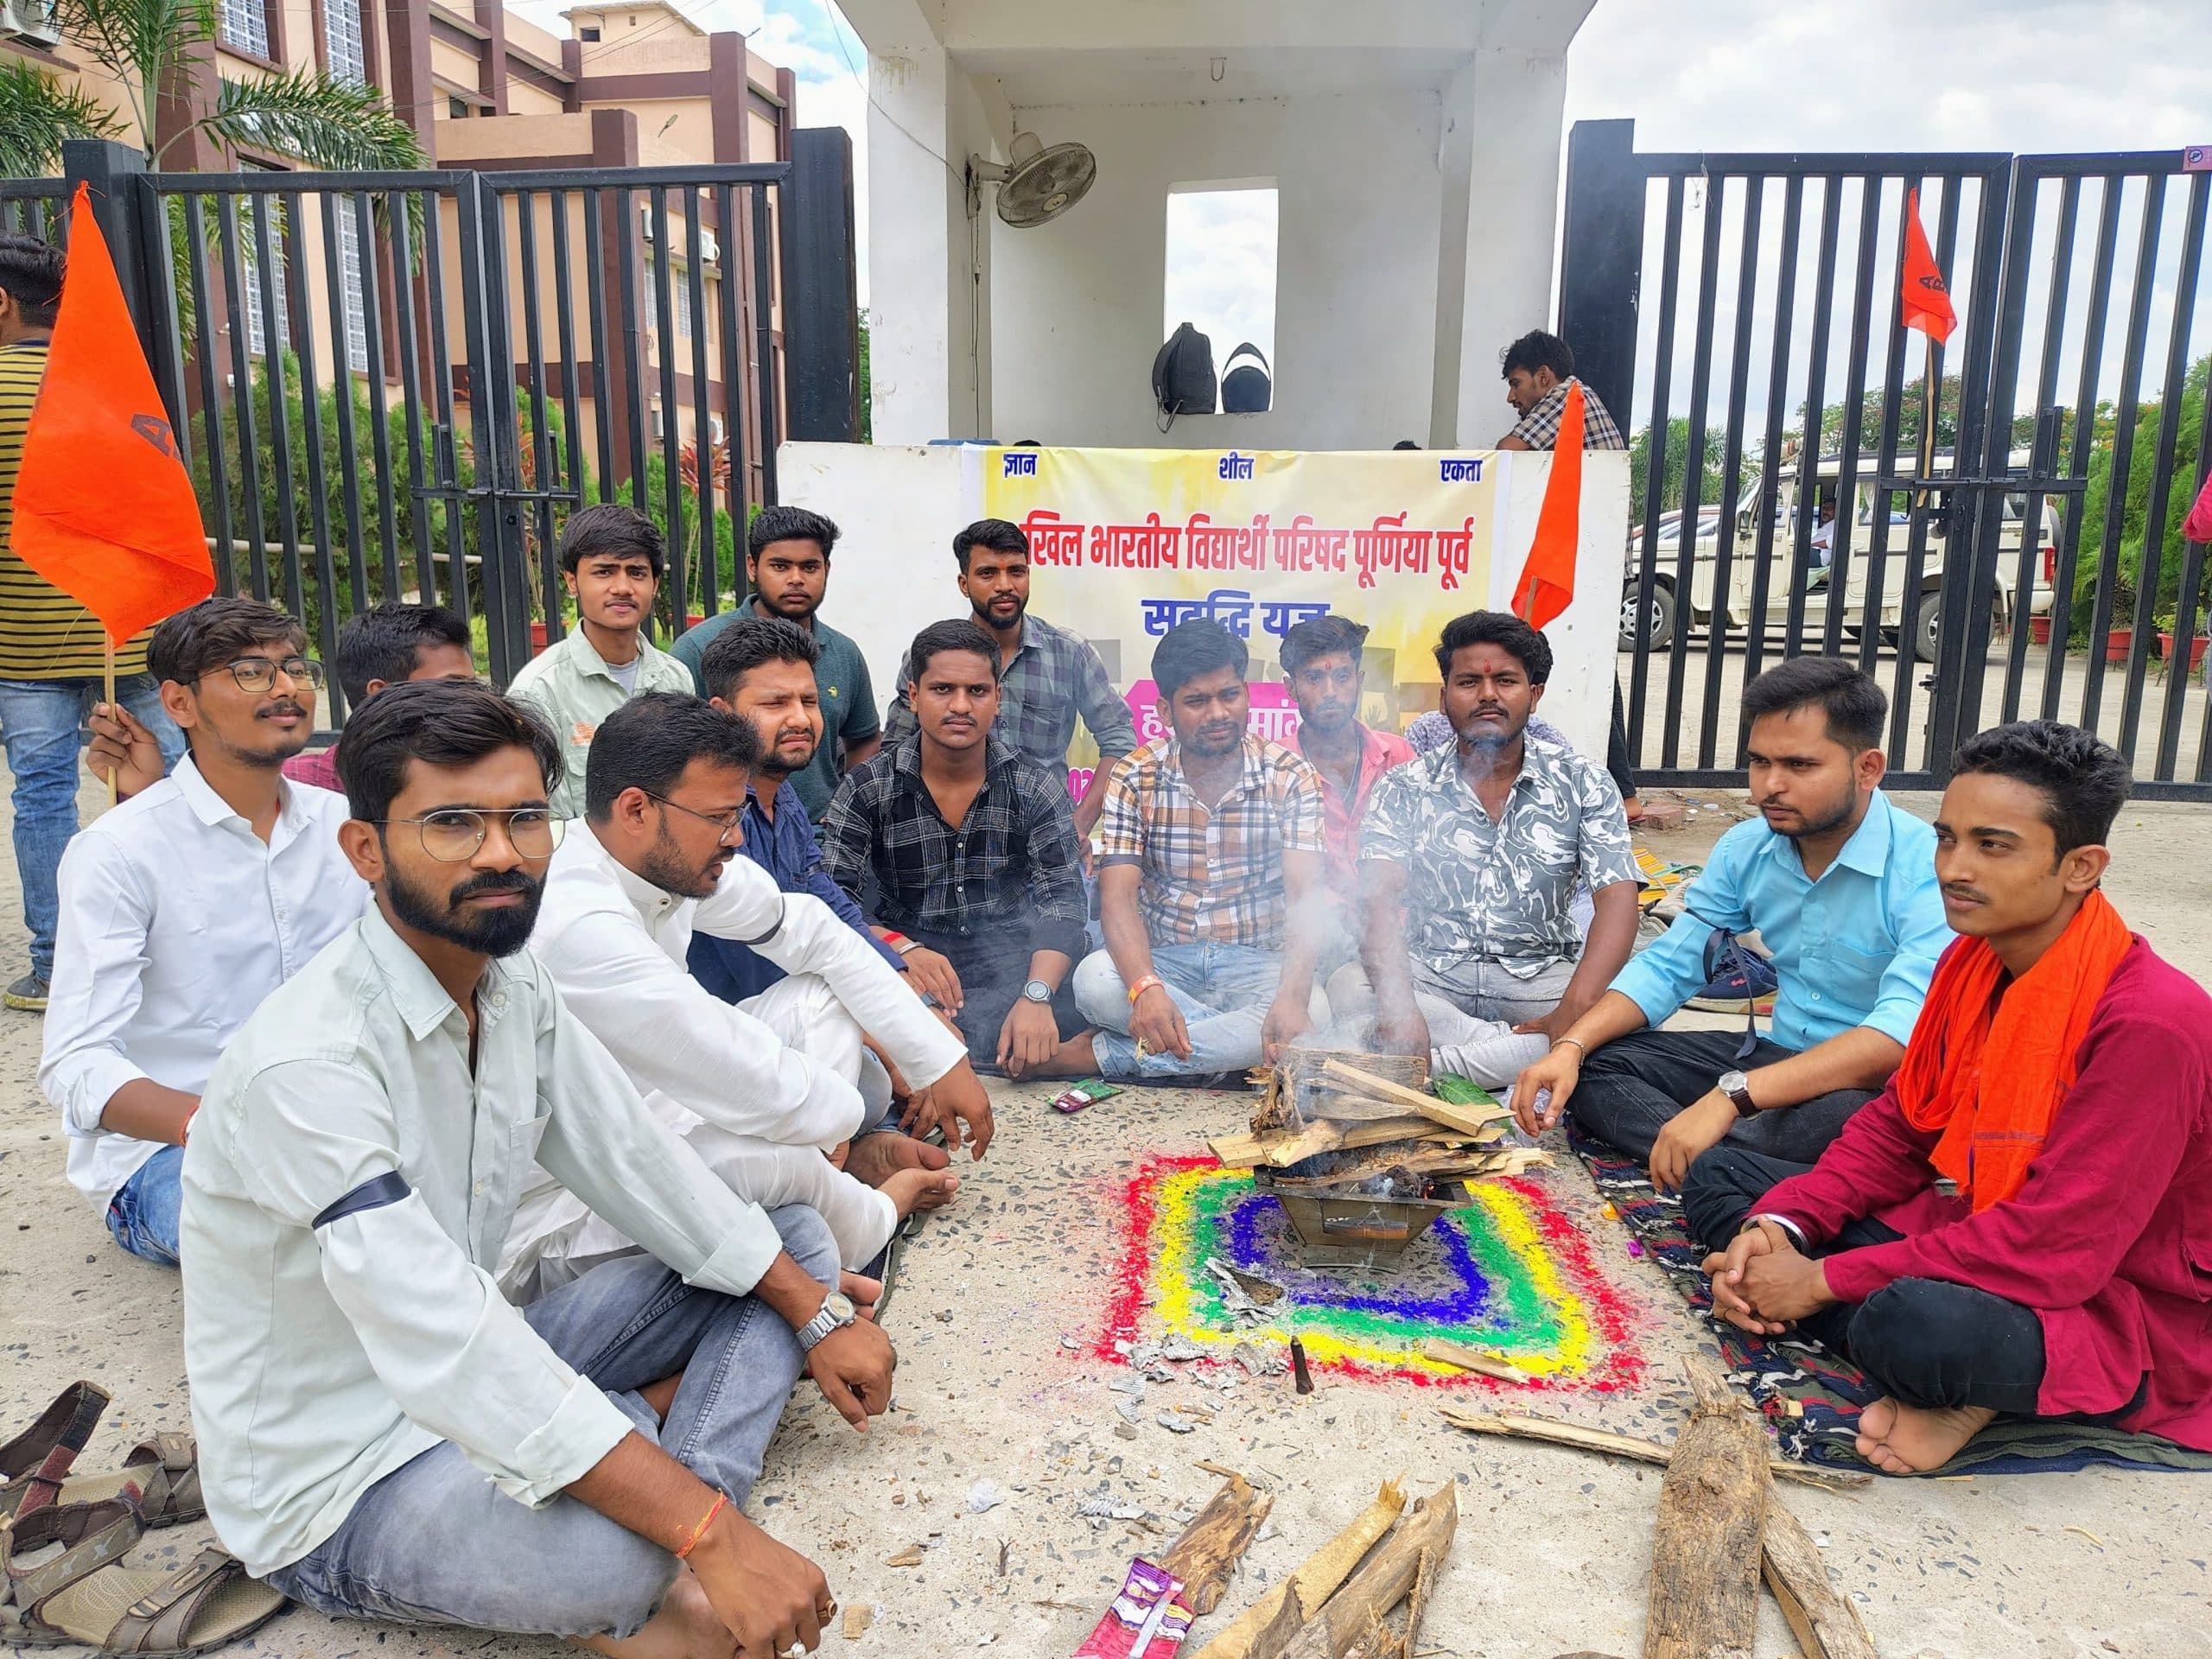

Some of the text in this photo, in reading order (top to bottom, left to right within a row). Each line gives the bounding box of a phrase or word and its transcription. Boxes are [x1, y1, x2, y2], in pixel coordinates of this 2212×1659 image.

[131, 414, 181, 461] A
[1003, 452, 1483, 481] ज्ञान शील एकता
[1090, 512, 1182, 569] भारतीय
[1185, 513, 1269, 570] विद्यार्थी
[1273, 515, 1350, 572] परिषद
[1353, 512, 1433, 588] पूर्णिया
[1436, 517, 1474, 589] पूर्व
